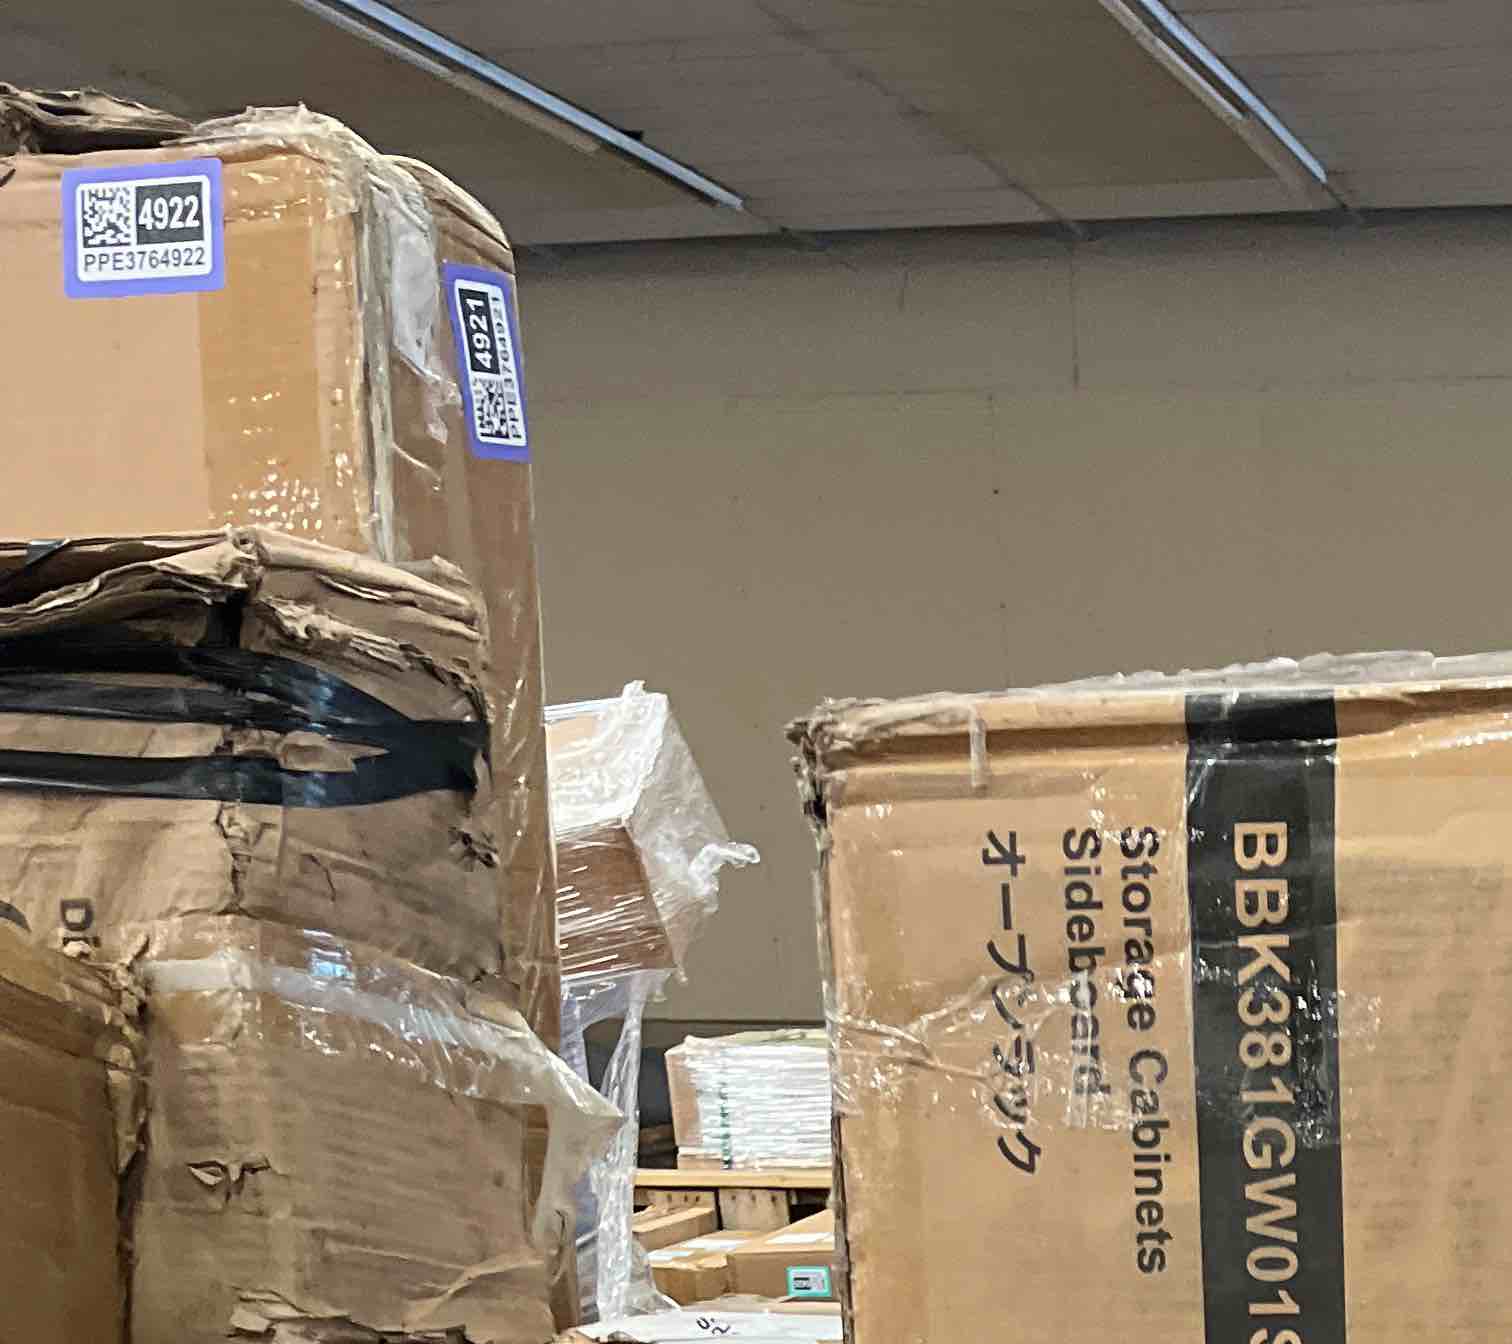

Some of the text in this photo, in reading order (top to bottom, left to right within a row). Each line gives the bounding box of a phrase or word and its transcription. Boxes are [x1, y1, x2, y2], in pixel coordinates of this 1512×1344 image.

[84, 247, 205, 272] PPE3764922
[138, 195, 200, 230] 4922
[466, 298, 492, 369] 4921
[491, 296, 522, 440] PPE3764921
[1062, 827, 1111, 1097] Sideboard
[1114, 826, 1174, 1272] Storage Cabinets
